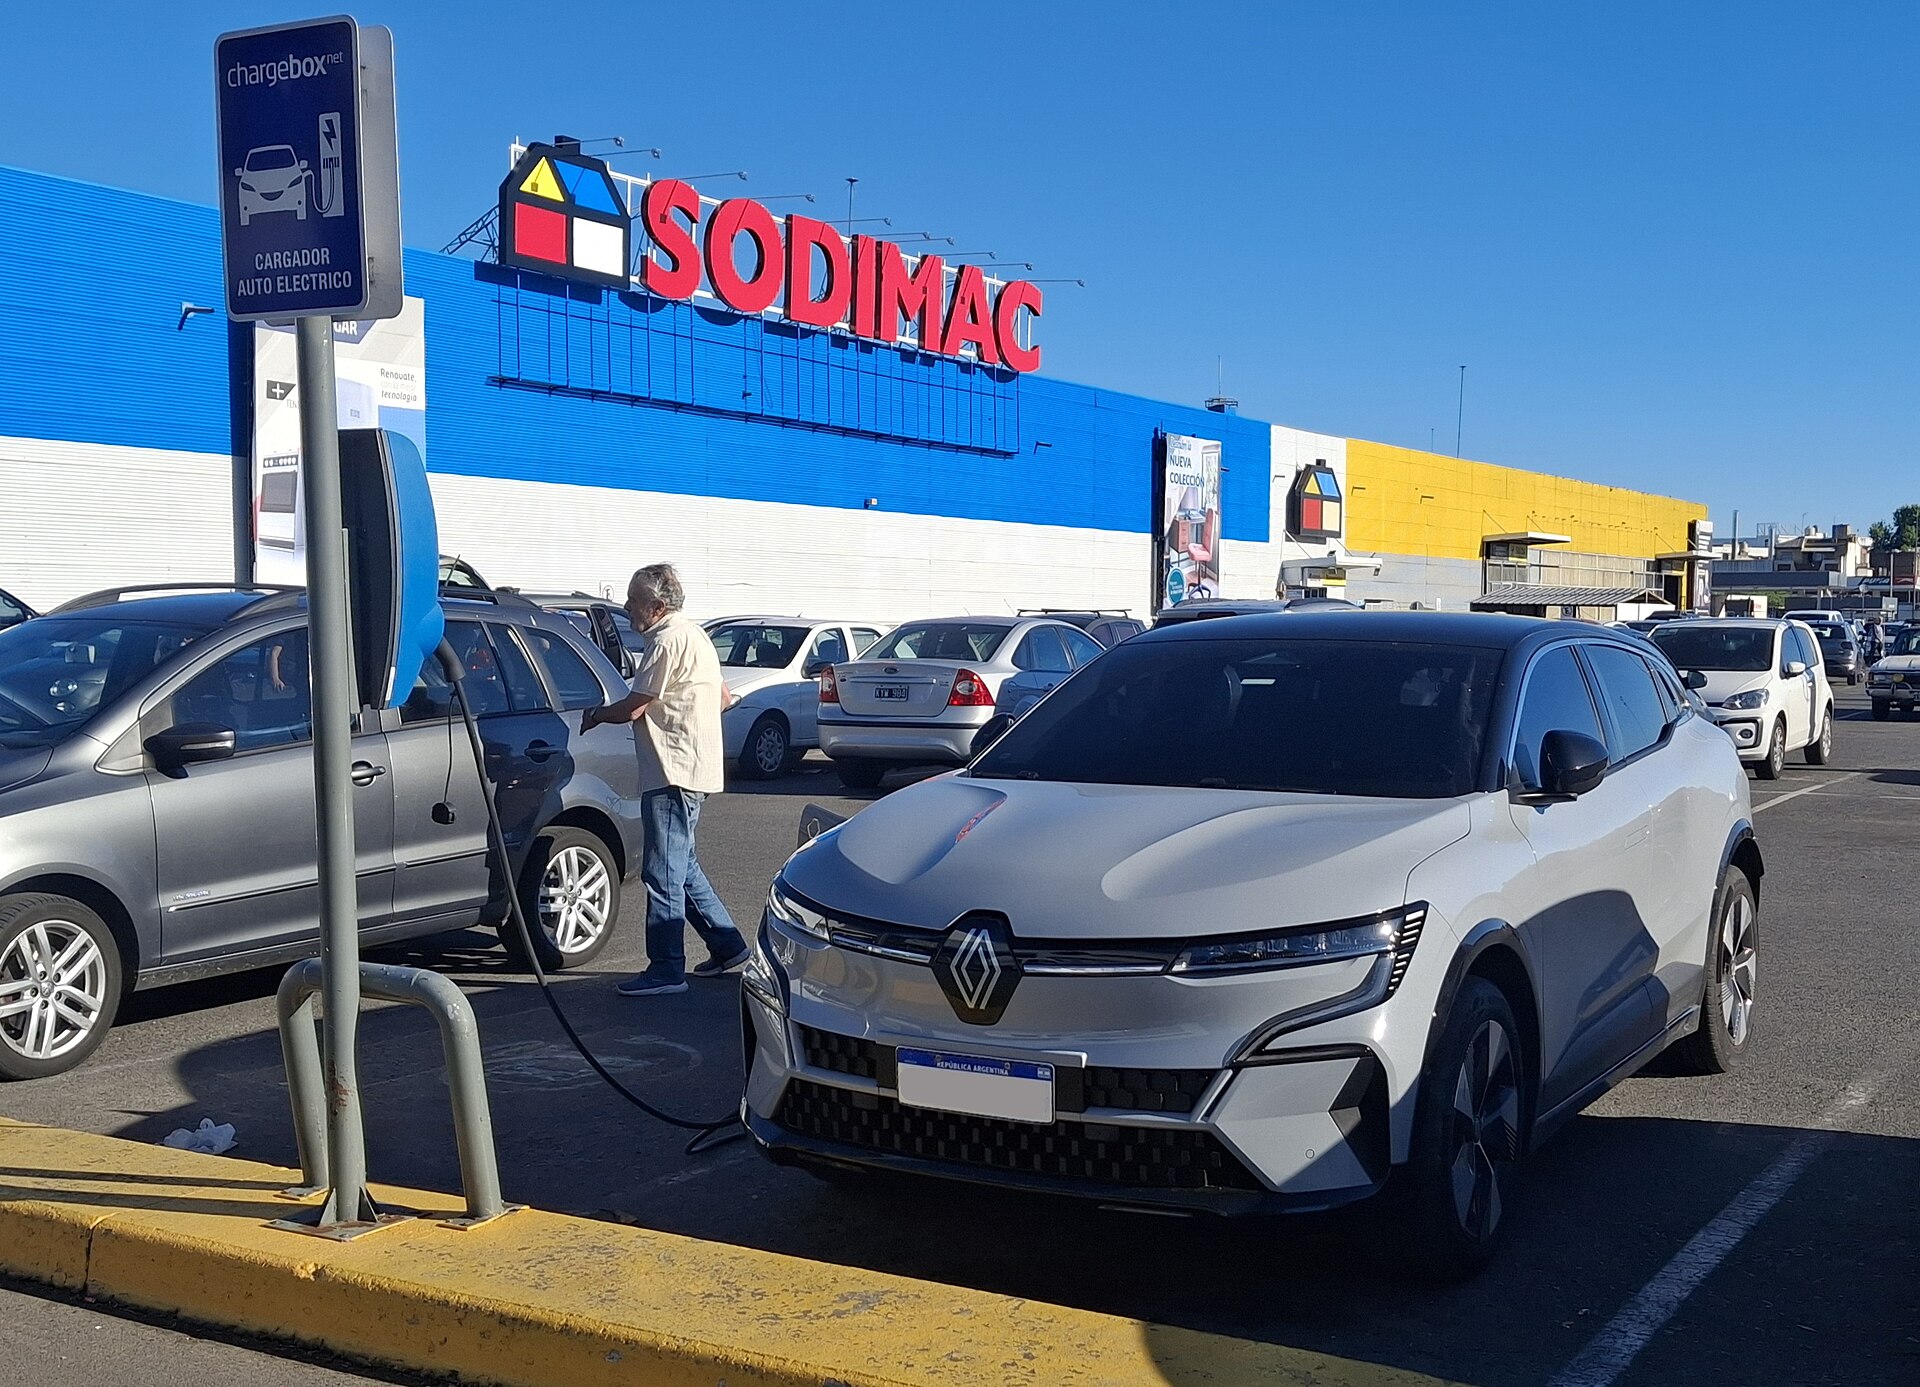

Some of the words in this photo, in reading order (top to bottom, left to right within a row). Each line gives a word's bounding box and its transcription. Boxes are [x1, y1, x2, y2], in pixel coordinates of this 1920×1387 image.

[255, 247, 330, 270] CARGADOR
[237, 277, 273, 297] AUTO
[276, 270, 352, 293] ELECTRICO
[640, 178, 1042, 372] SODIMAC
[1169, 455, 1192, 468] NUEVA
[1169, 472, 1205, 488] COLECCIÓN
[936, 1060, 971, 1071] REPÚBLICA
[973, 1065, 1009, 1076] ARGENTINA
